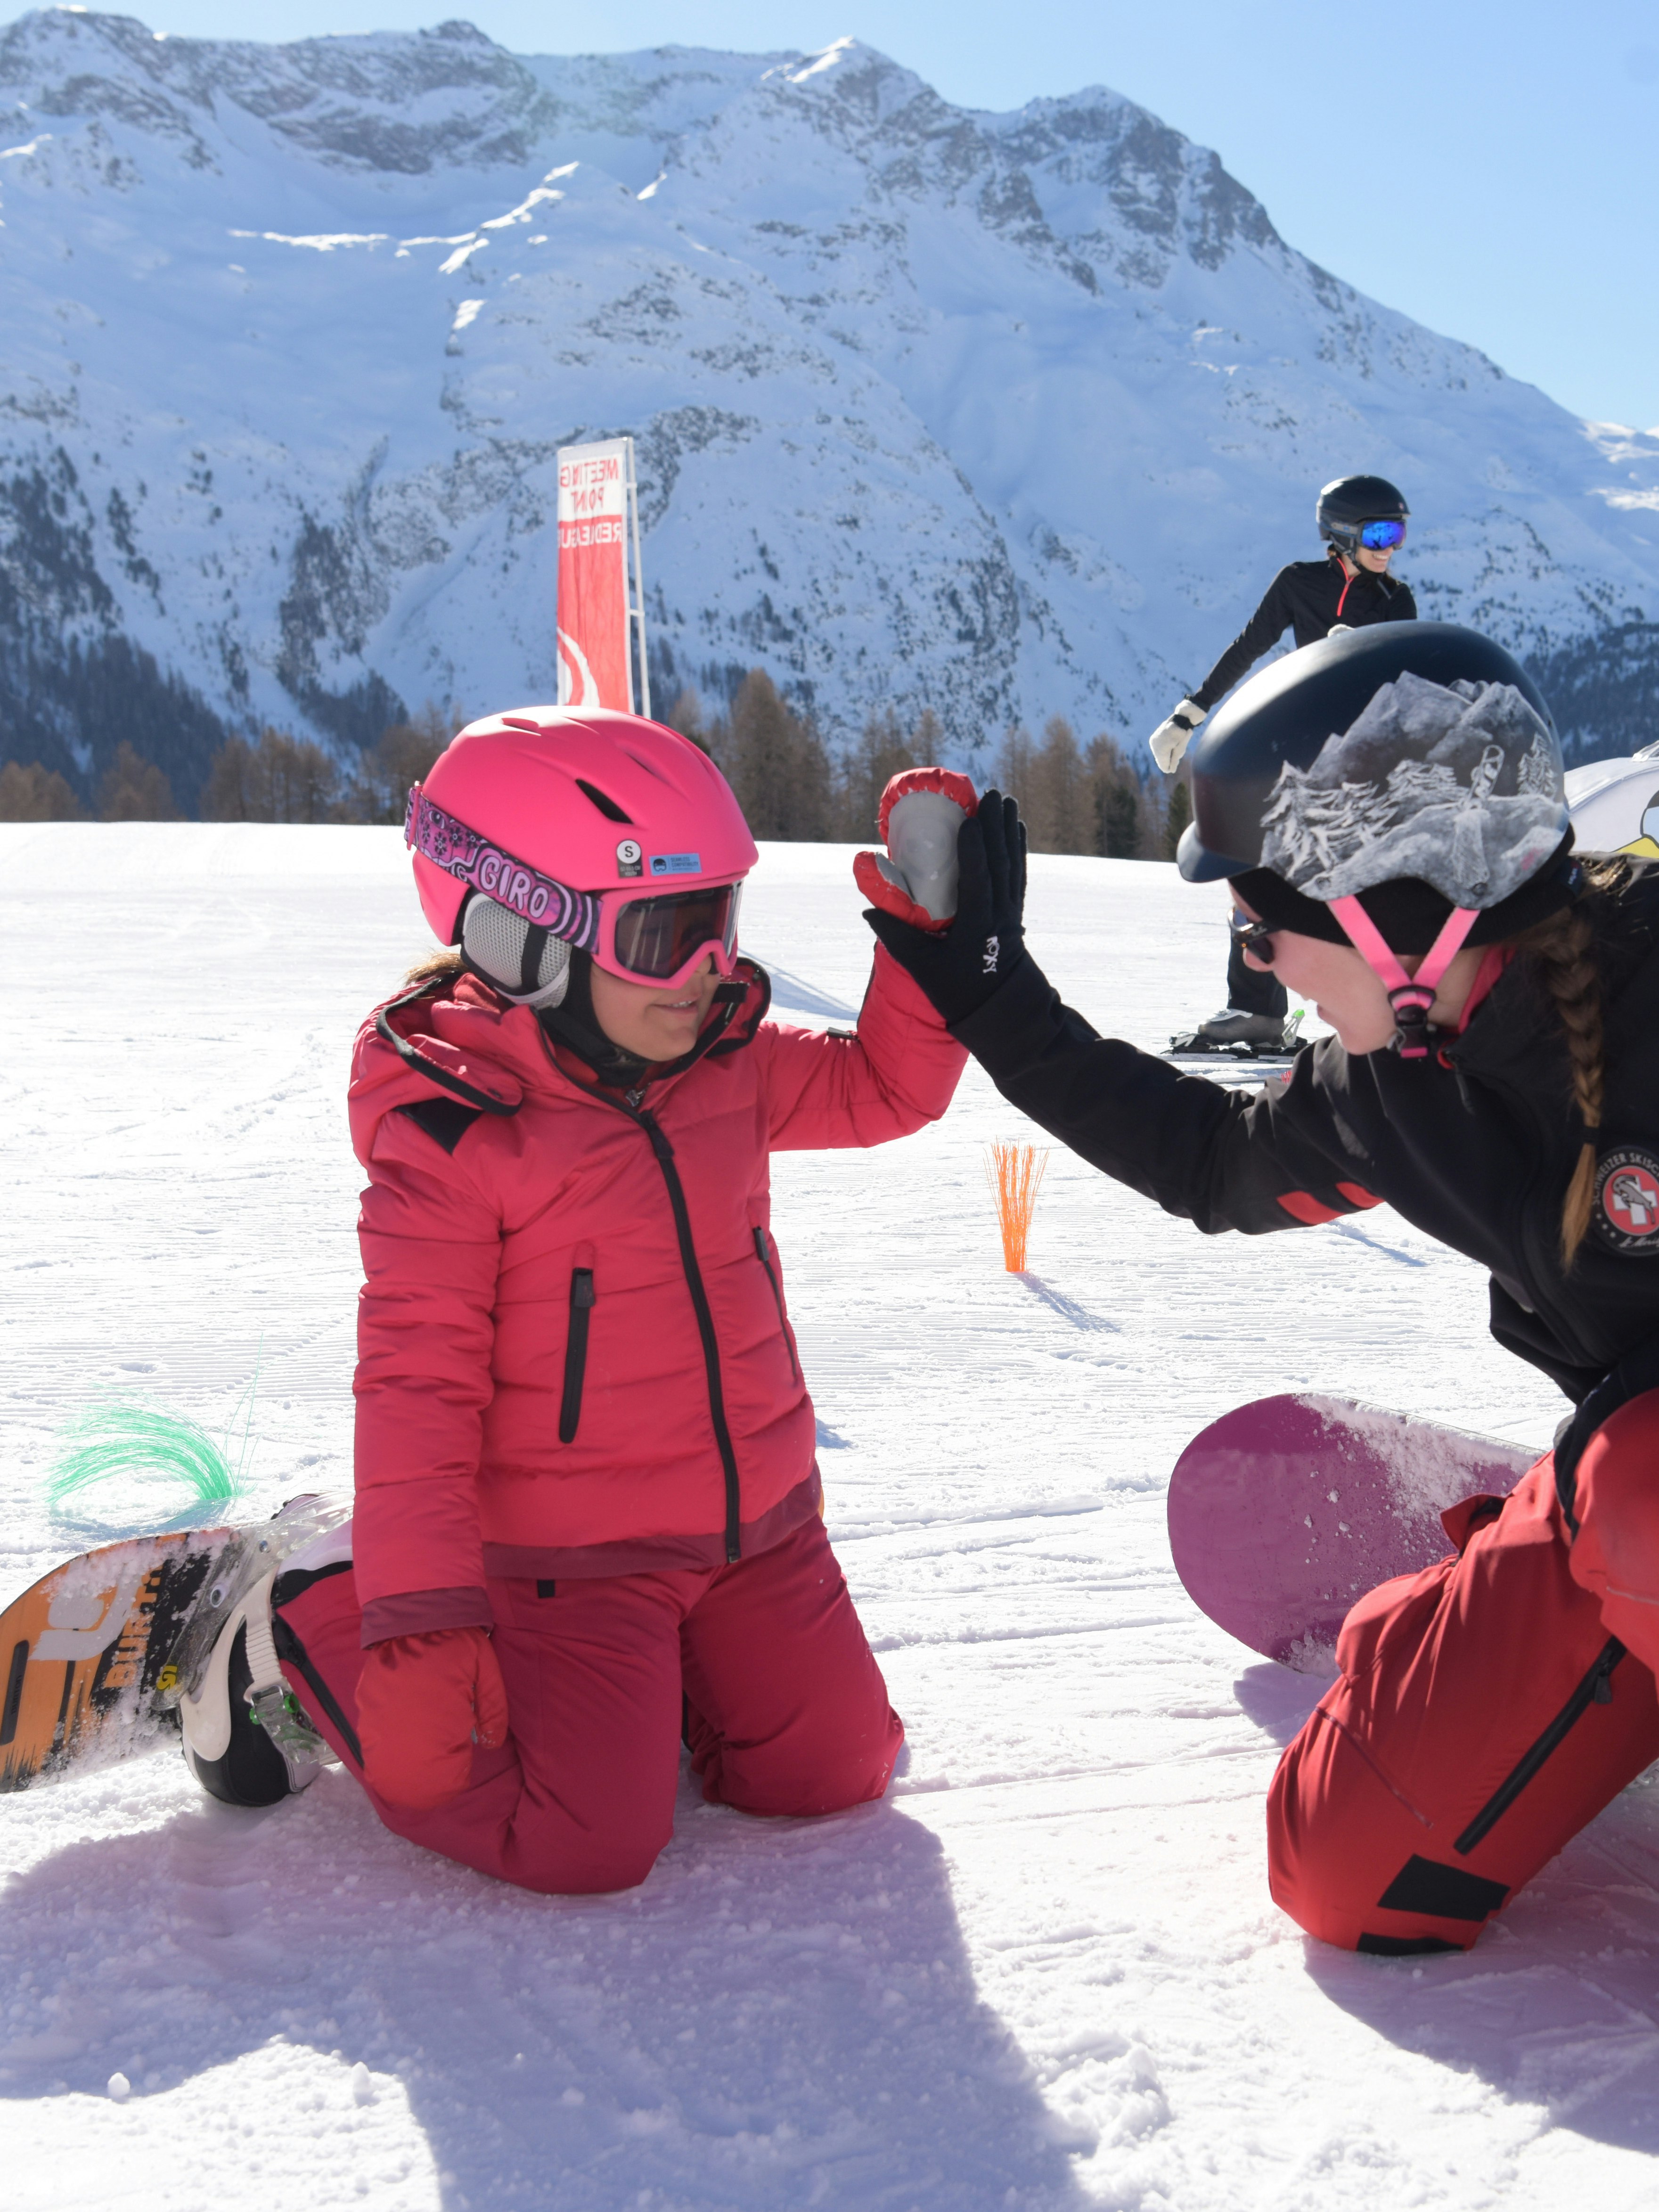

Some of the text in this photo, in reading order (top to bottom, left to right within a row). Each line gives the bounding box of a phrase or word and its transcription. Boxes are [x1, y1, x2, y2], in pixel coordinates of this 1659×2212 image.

[624, 846, 634, 858] S
[480, 855, 549, 918] GIRO
[982, 935, 1000, 974] ROXY
[1629, 1152, 1659, 1177] SKISC
